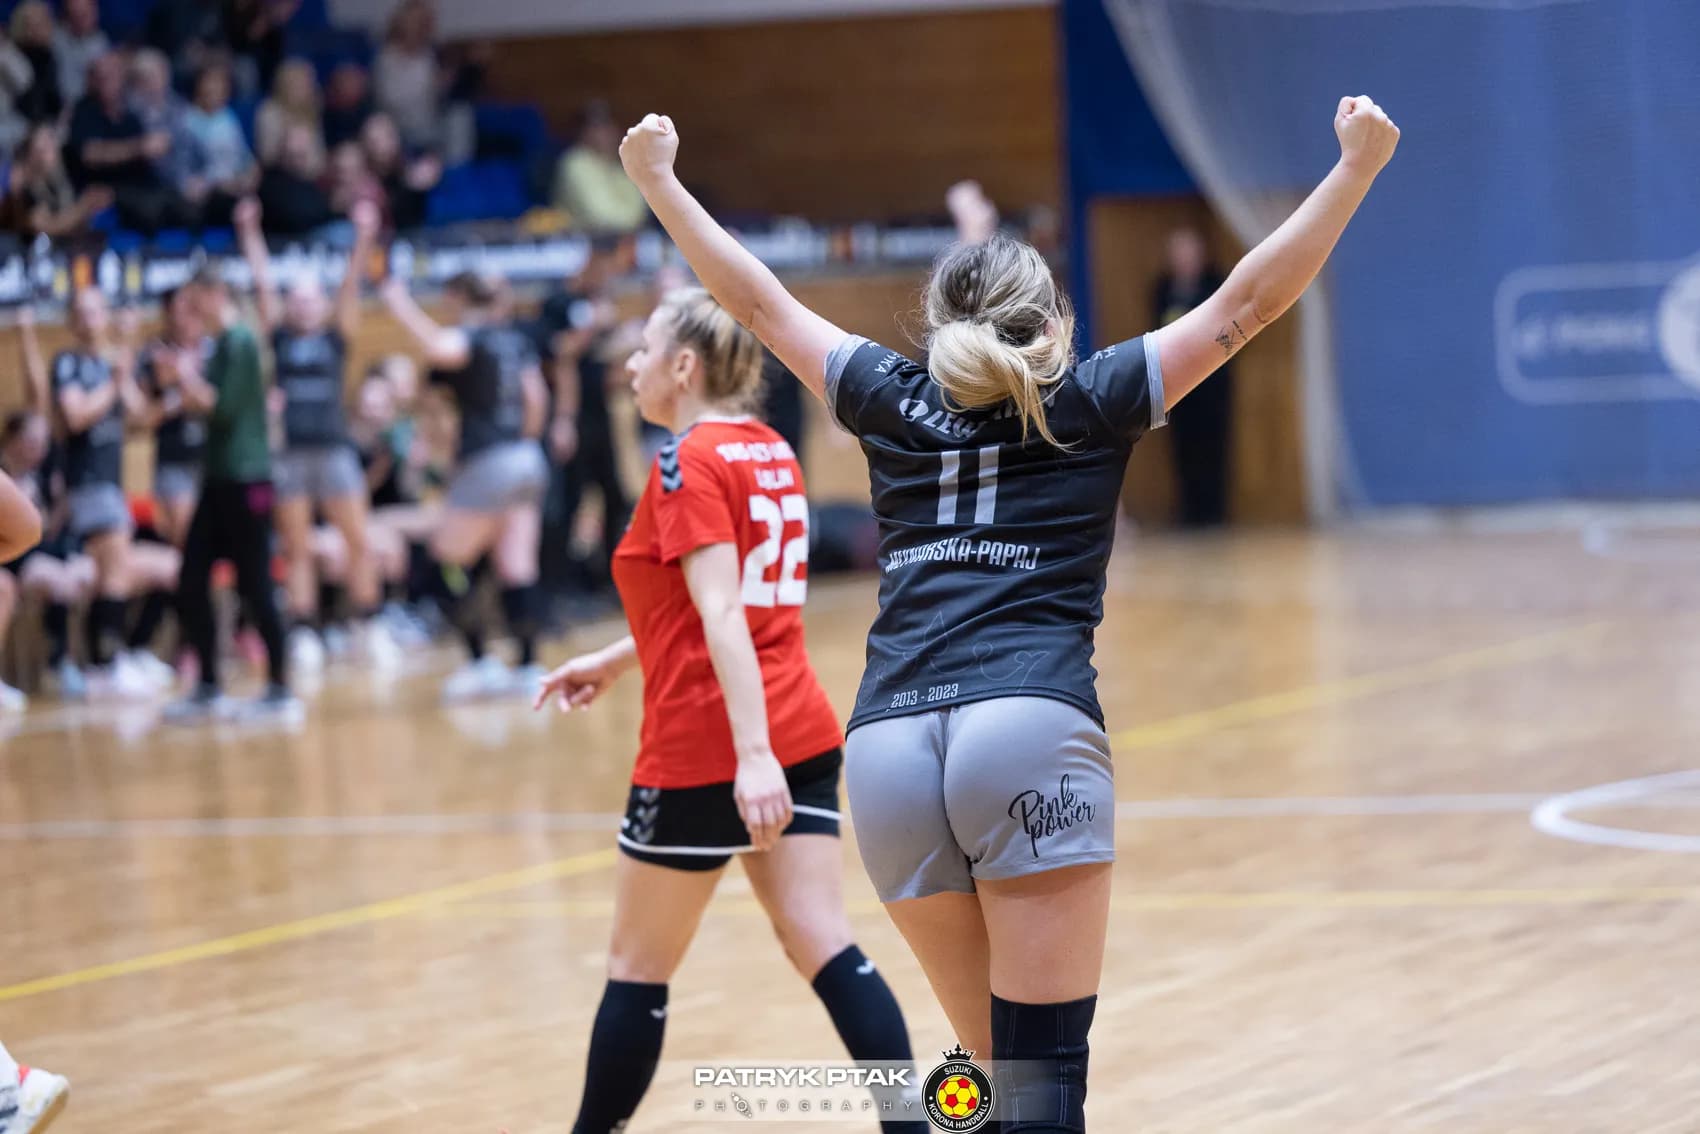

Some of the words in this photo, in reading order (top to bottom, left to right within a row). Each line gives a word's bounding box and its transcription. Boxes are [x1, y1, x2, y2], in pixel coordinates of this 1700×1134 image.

[936, 445, 1000, 525] 11
[741, 494, 809, 608] 22
[890, 689, 918, 708] 2013
[927, 683, 959, 702] 2023
[1008, 773, 1078, 835] Pink
[1030, 801, 1096, 858] power
